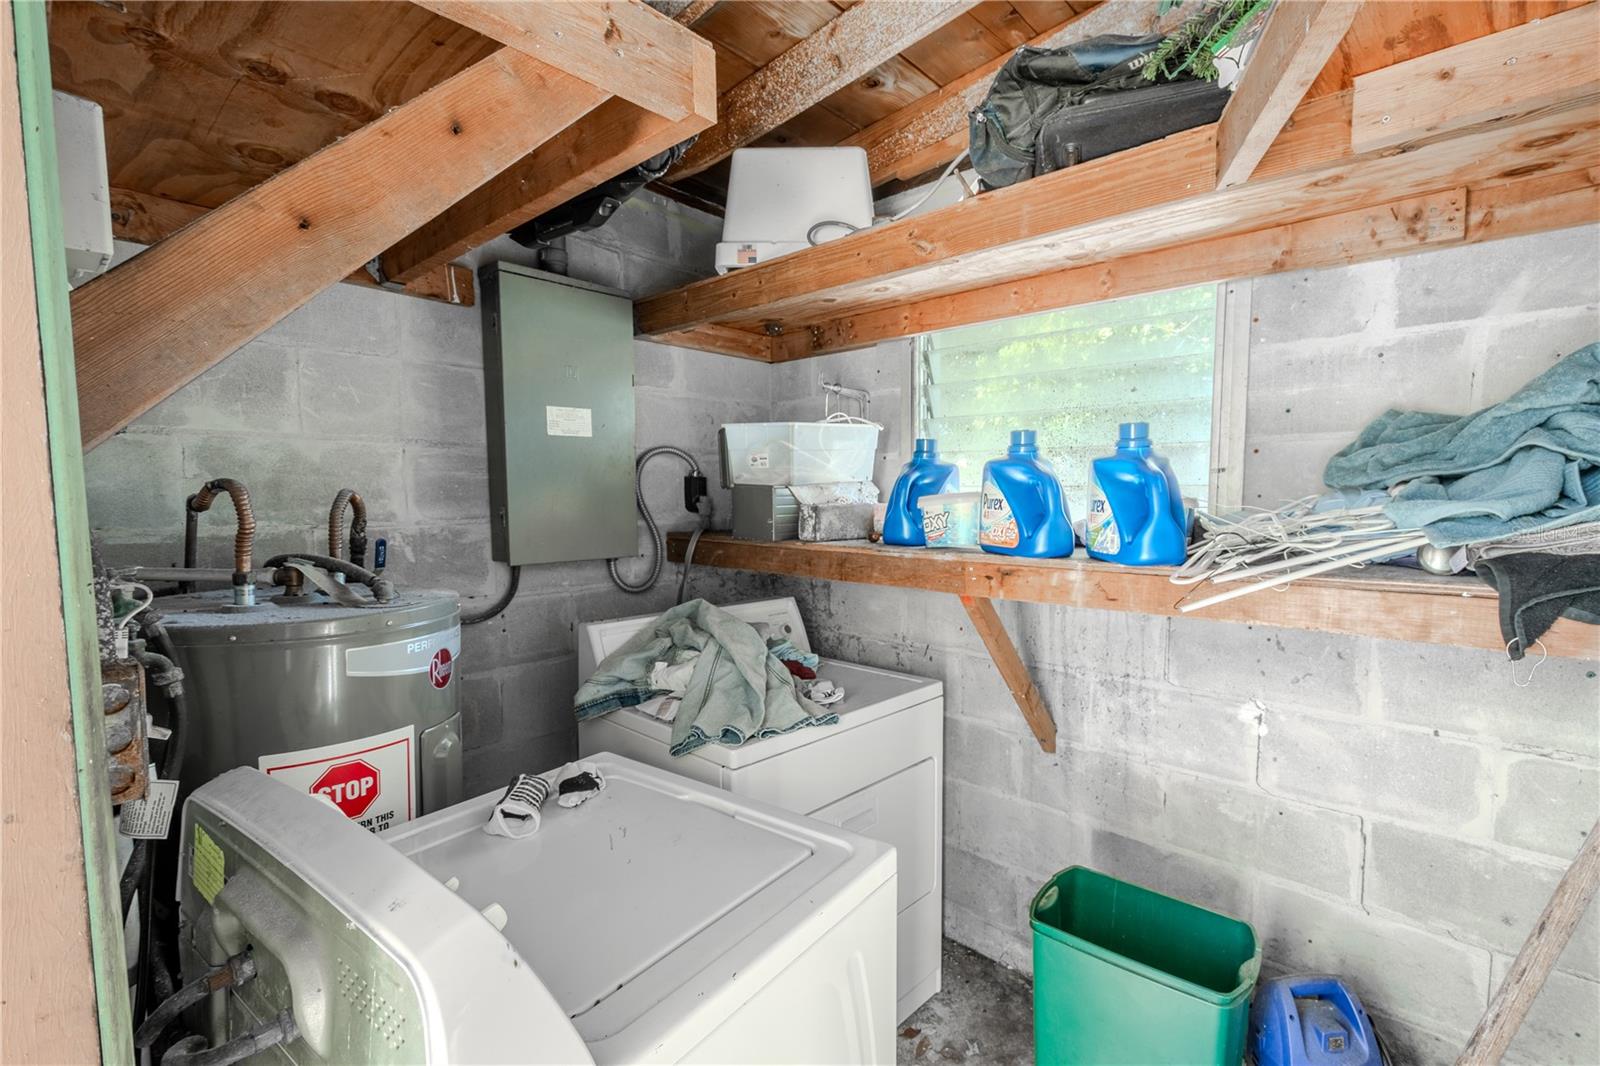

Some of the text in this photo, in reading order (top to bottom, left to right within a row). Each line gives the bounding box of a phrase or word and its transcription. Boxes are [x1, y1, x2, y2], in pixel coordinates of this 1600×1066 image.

[984, 493, 1003, 511] Purex
[317, 776, 374, 804] STOP
[375, 810, 395, 824] THIS
